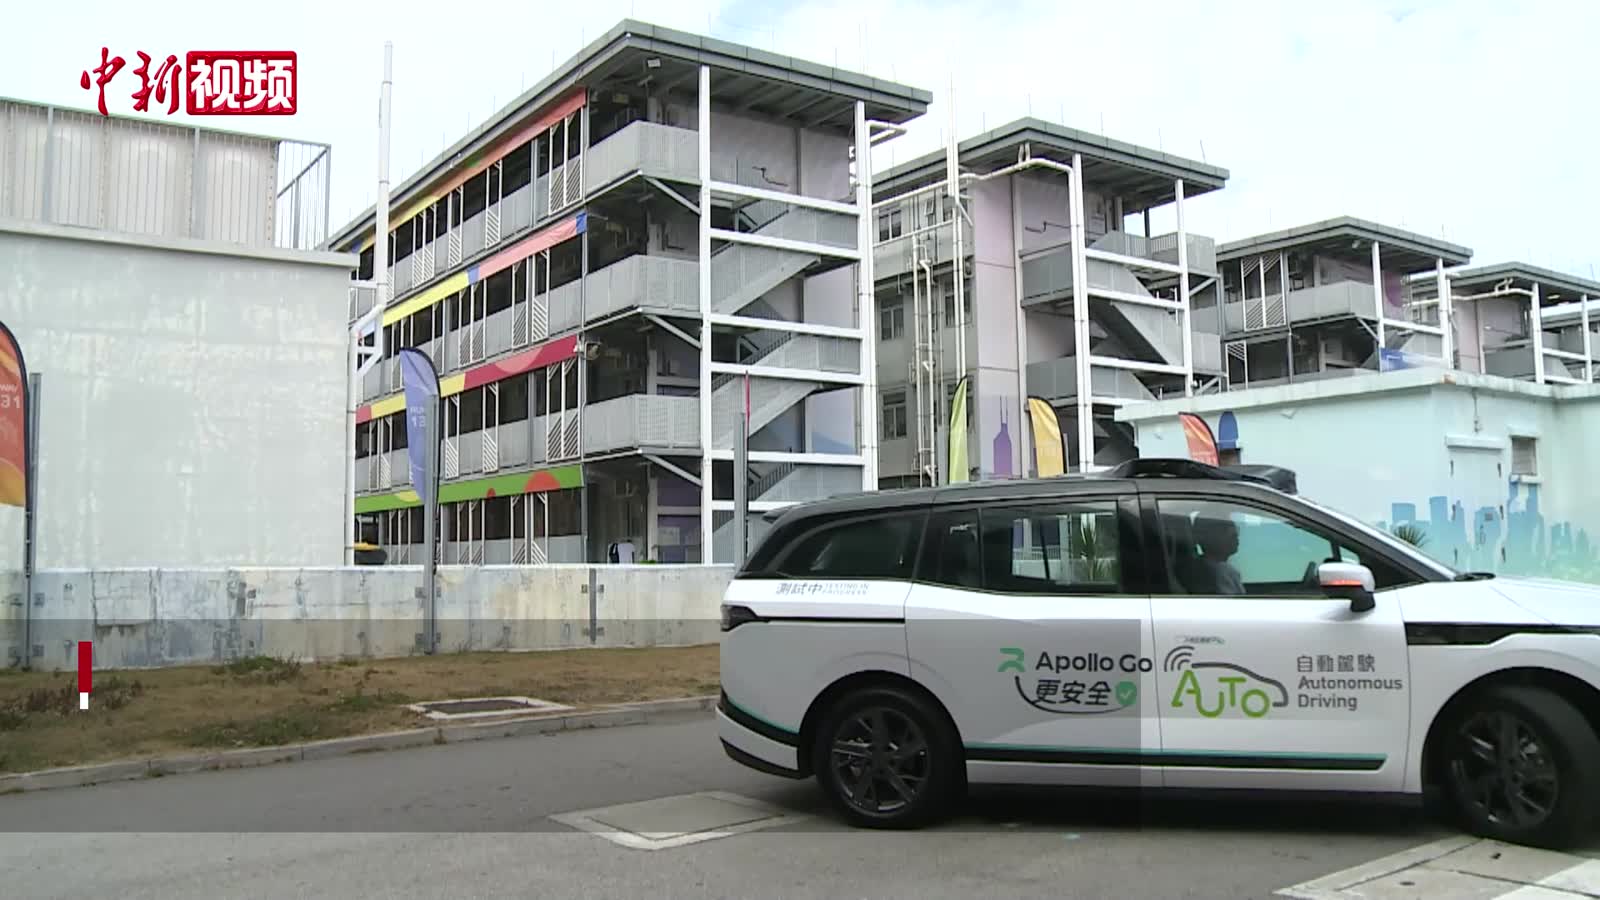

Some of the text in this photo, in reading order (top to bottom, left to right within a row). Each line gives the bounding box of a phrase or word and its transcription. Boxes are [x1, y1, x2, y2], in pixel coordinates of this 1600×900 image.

[0, 394, 21, 408] 31
[1035, 651, 1114, 673] Apollo
[1119, 654, 1153, 673] Go
[1296, 654, 1376, 673] 自動駕駛
[1297, 675, 1403, 690] Autonomous
[1035, 679, 1112, 706] 更安全
[1297, 693, 1358, 711] Driving
